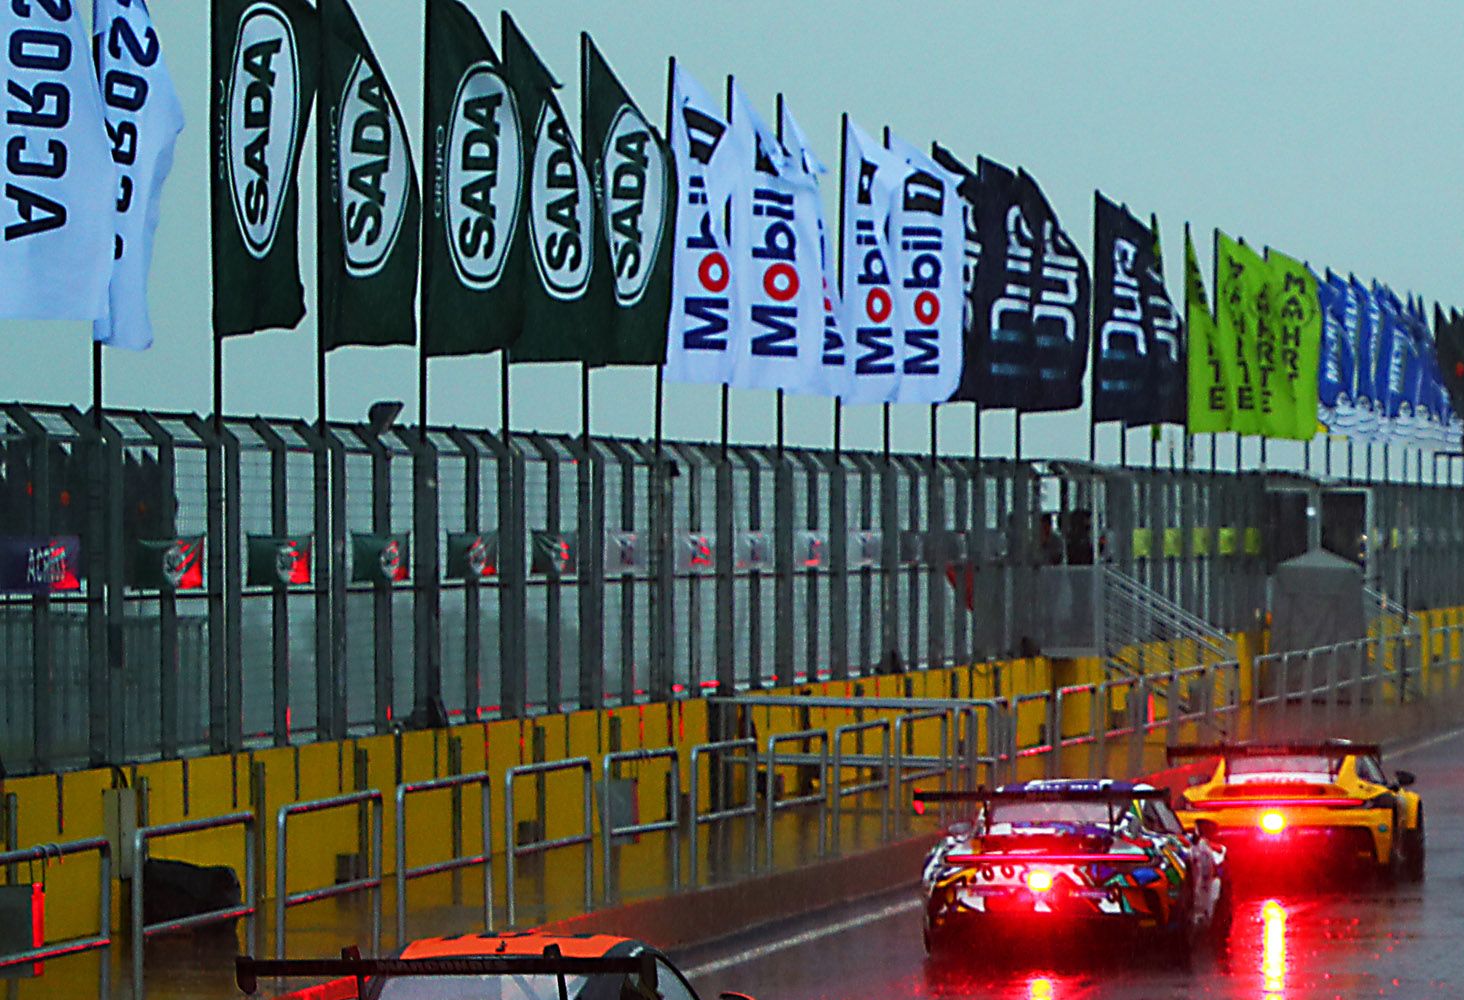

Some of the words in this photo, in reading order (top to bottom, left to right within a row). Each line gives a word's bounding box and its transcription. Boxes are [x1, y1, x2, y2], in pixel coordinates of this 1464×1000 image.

[243, 37, 283, 226] SADA
[346, 72, 391, 246] SADA
[458, 92, 504, 260] SADA
[544, 112, 582, 272] SADA
[612, 130, 651, 279] SADA
[751, 188, 799, 357] Mobil
[855, 219, 896, 375] Mobil
[902, 225, 943, 375] Mobil
